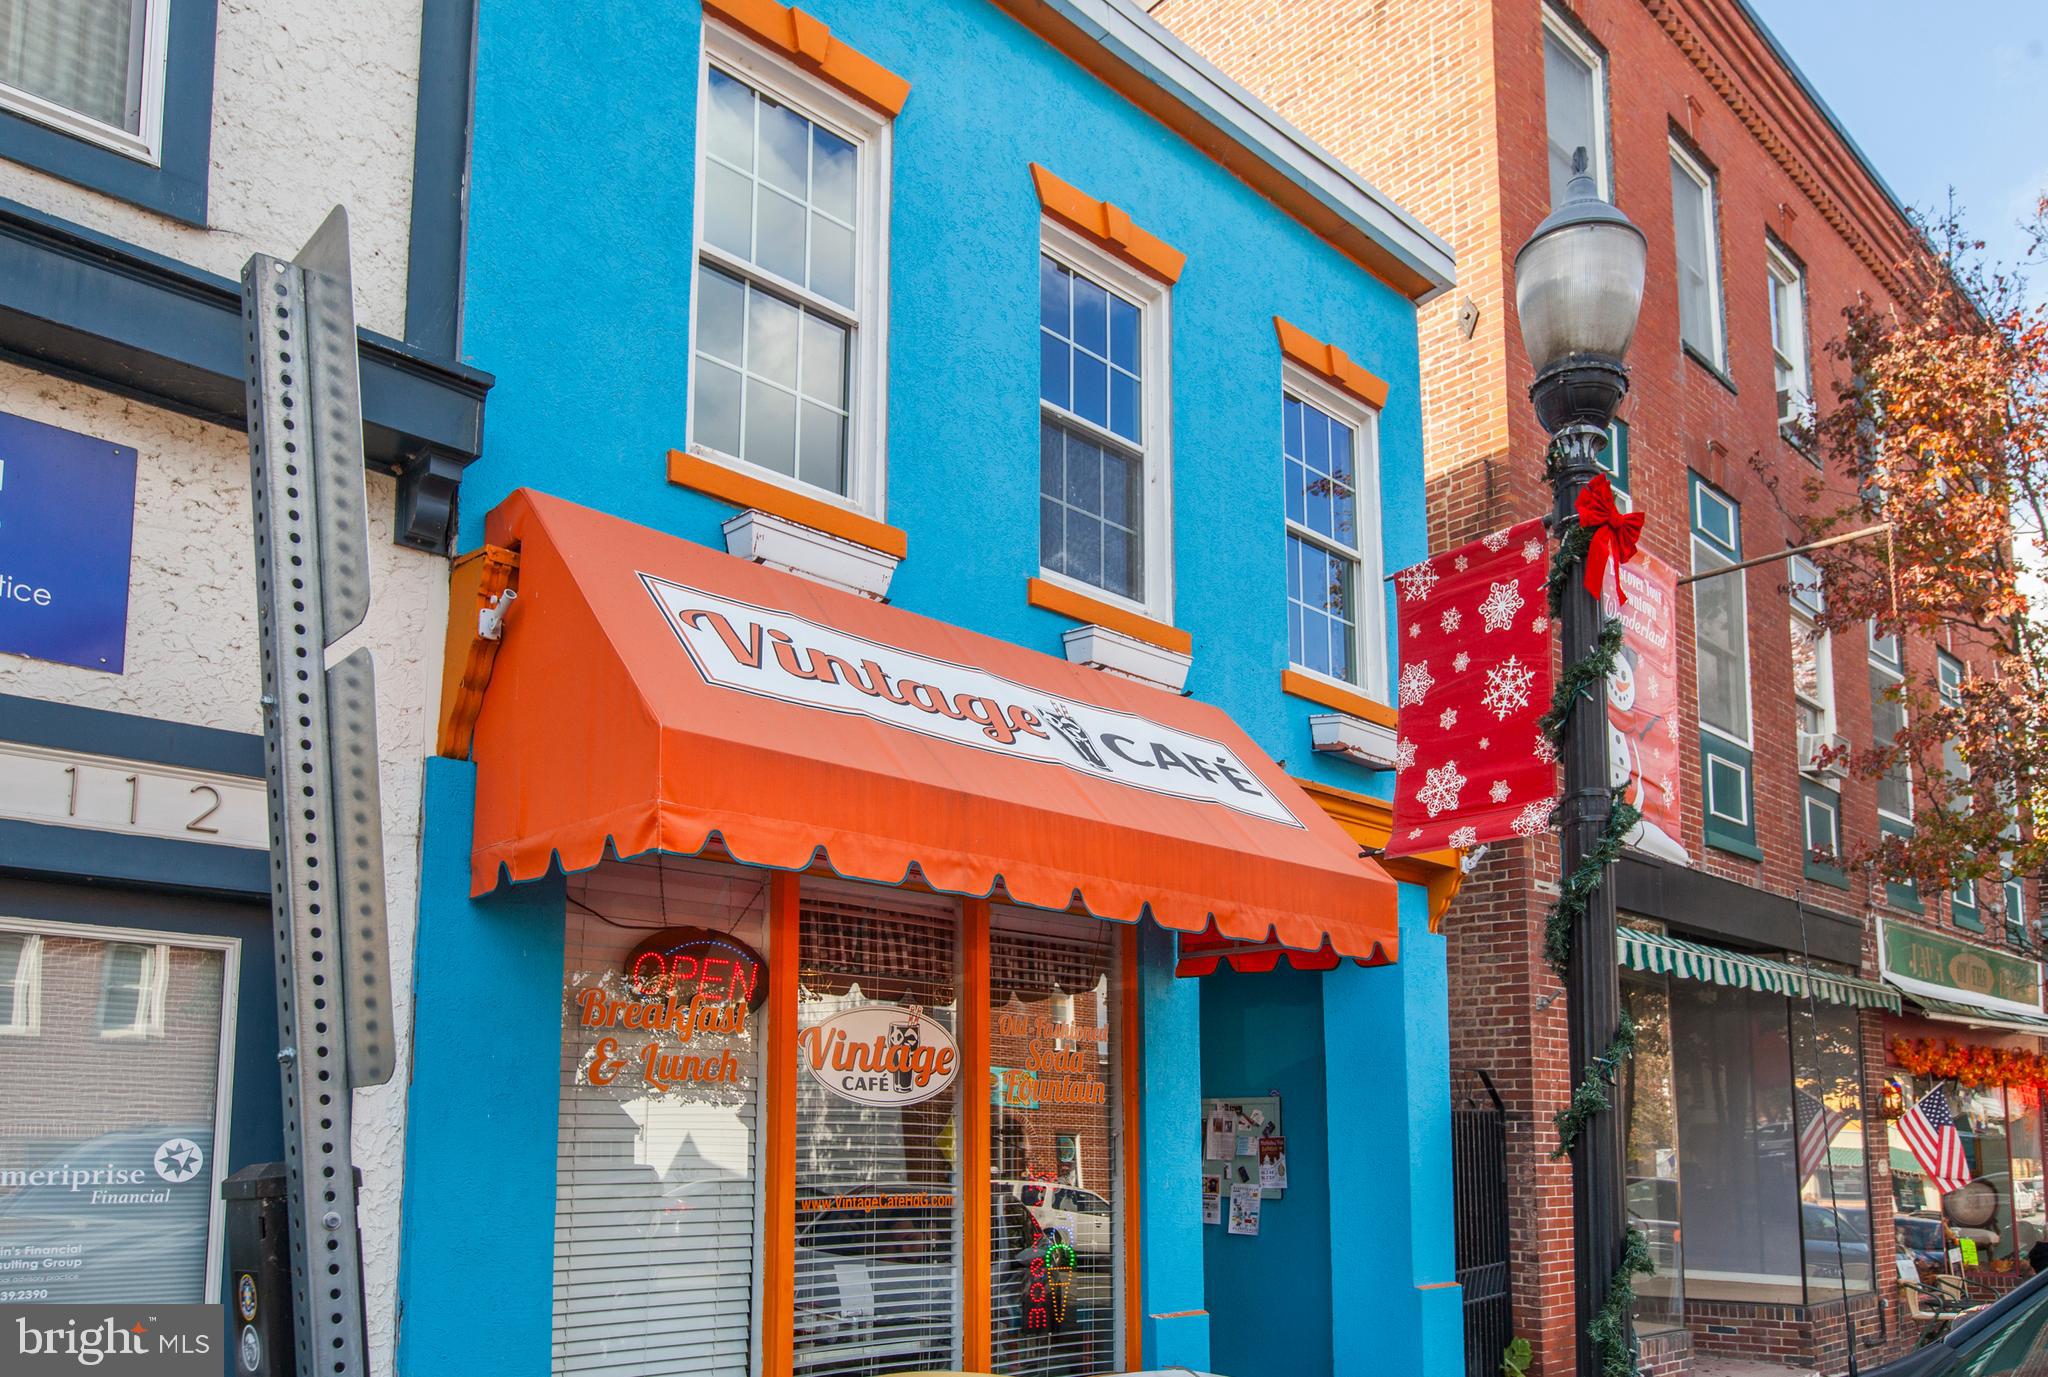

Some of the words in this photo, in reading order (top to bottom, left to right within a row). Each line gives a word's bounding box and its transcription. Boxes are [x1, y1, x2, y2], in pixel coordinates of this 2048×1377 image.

[1602, 592, 1669, 649] Wonderland
[679, 608, 1051, 745] Vintage
[1099, 733, 1264, 797] CAFÉ
[633, 952, 759, 1002] OPEN
[577, 986, 748, 1044] Breakfast
[587, 1035, 629, 1087] &
[640, 1042, 738, 1093] Lunch
[799, 1026, 955, 1088] Vintage
[1025, 1039, 1086, 1073] Soda
[841, 1073, 889, 1092] CAFÉ
[1001, 1069, 1106, 1106] Fountain
[90, 1188, 171, 1205] Financial
[800, 1191, 956, 1213] www.VintageCafeHdG.com
[24, 1244, 82, 1256] Financial
[42, 1257, 82, 1269] Group
